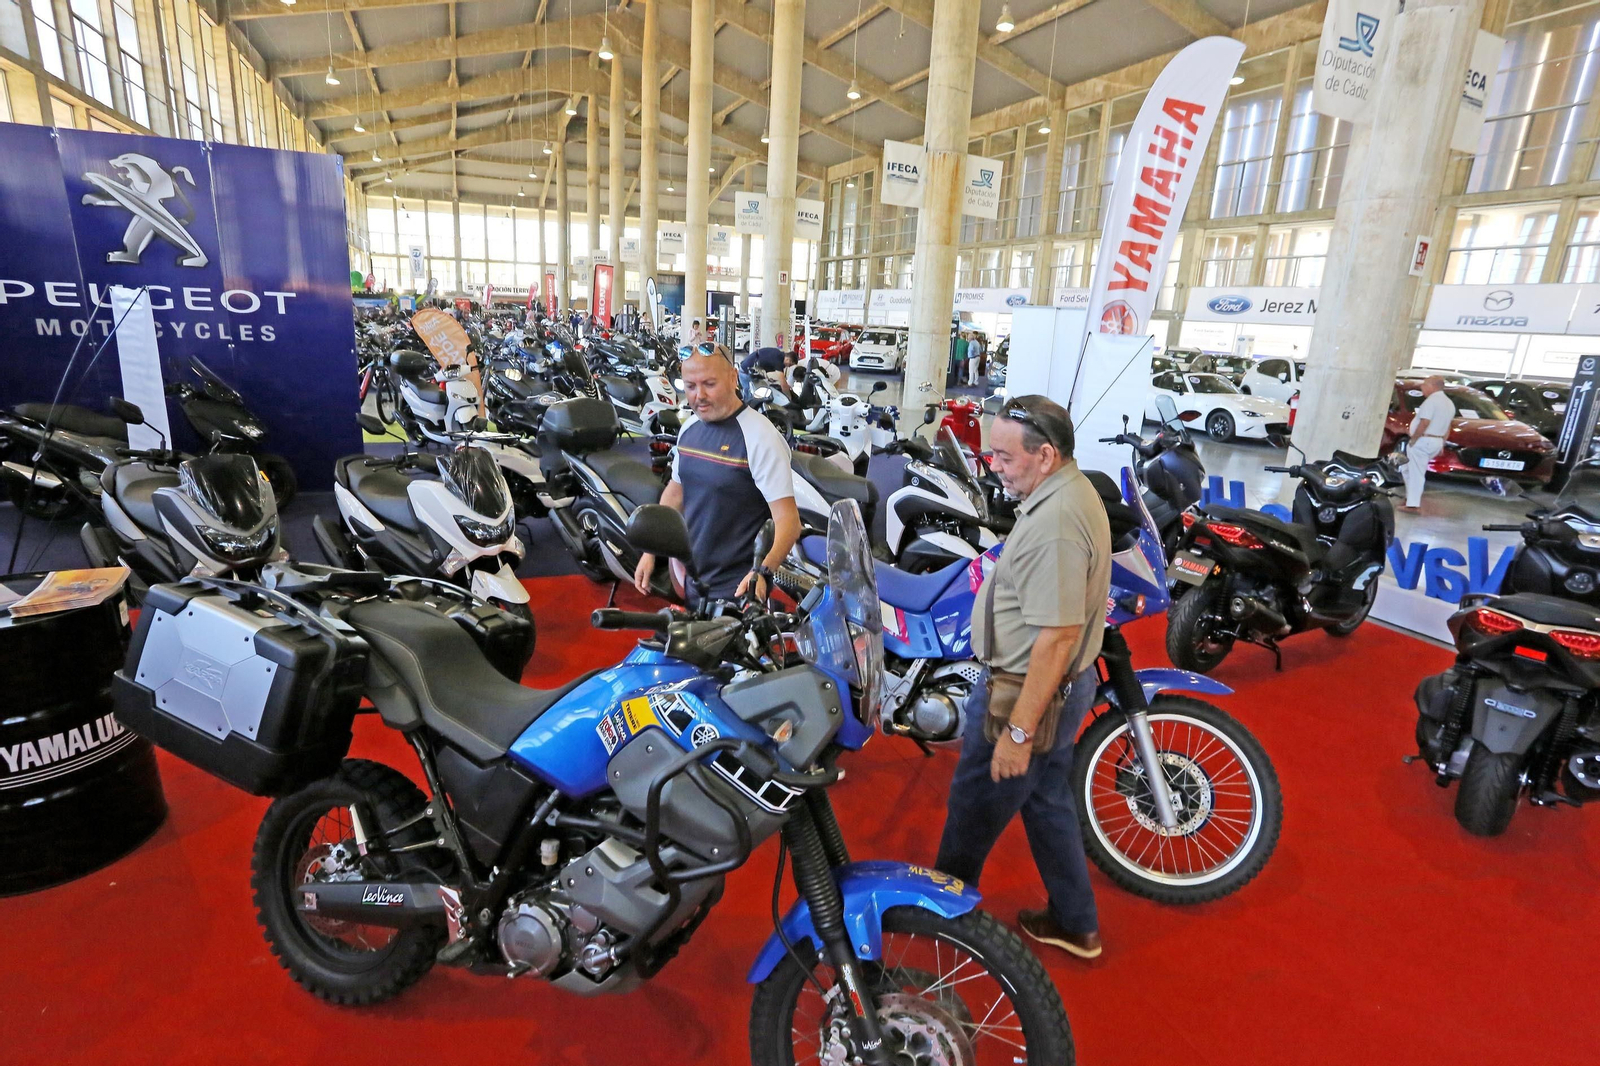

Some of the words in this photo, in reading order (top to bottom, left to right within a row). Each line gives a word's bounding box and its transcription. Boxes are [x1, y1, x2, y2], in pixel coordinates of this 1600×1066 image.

[1322, 49, 1376, 79] Diputación
[1325, 75, 1340, 92] de
[1342, 79, 1369, 101] Cádiz
[1465, 69, 1487, 92] ECA
[887, 161, 918, 175] IFECA
[965, 185, 996, 199] Diputación
[1107, 97, 1206, 292] YAMAHA
[797, 210, 819, 220] IFECA
[0, 279, 297, 315] PEUGEOT
[962, 292, 985, 301] PROMISE
[1060, 294, 1075, 303] Ford
[1214, 298, 1244, 312] Ford
[1260, 298, 1304, 314] Jerez
[1306, 299, 1319, 314] M
[1456, 315, 1529, 327] mazda
[1181, 560, 1209, 575] YAMAHA
[0, 712, 126, 774] YAMALUB
[362, 885, 404, 903] LeoVince
